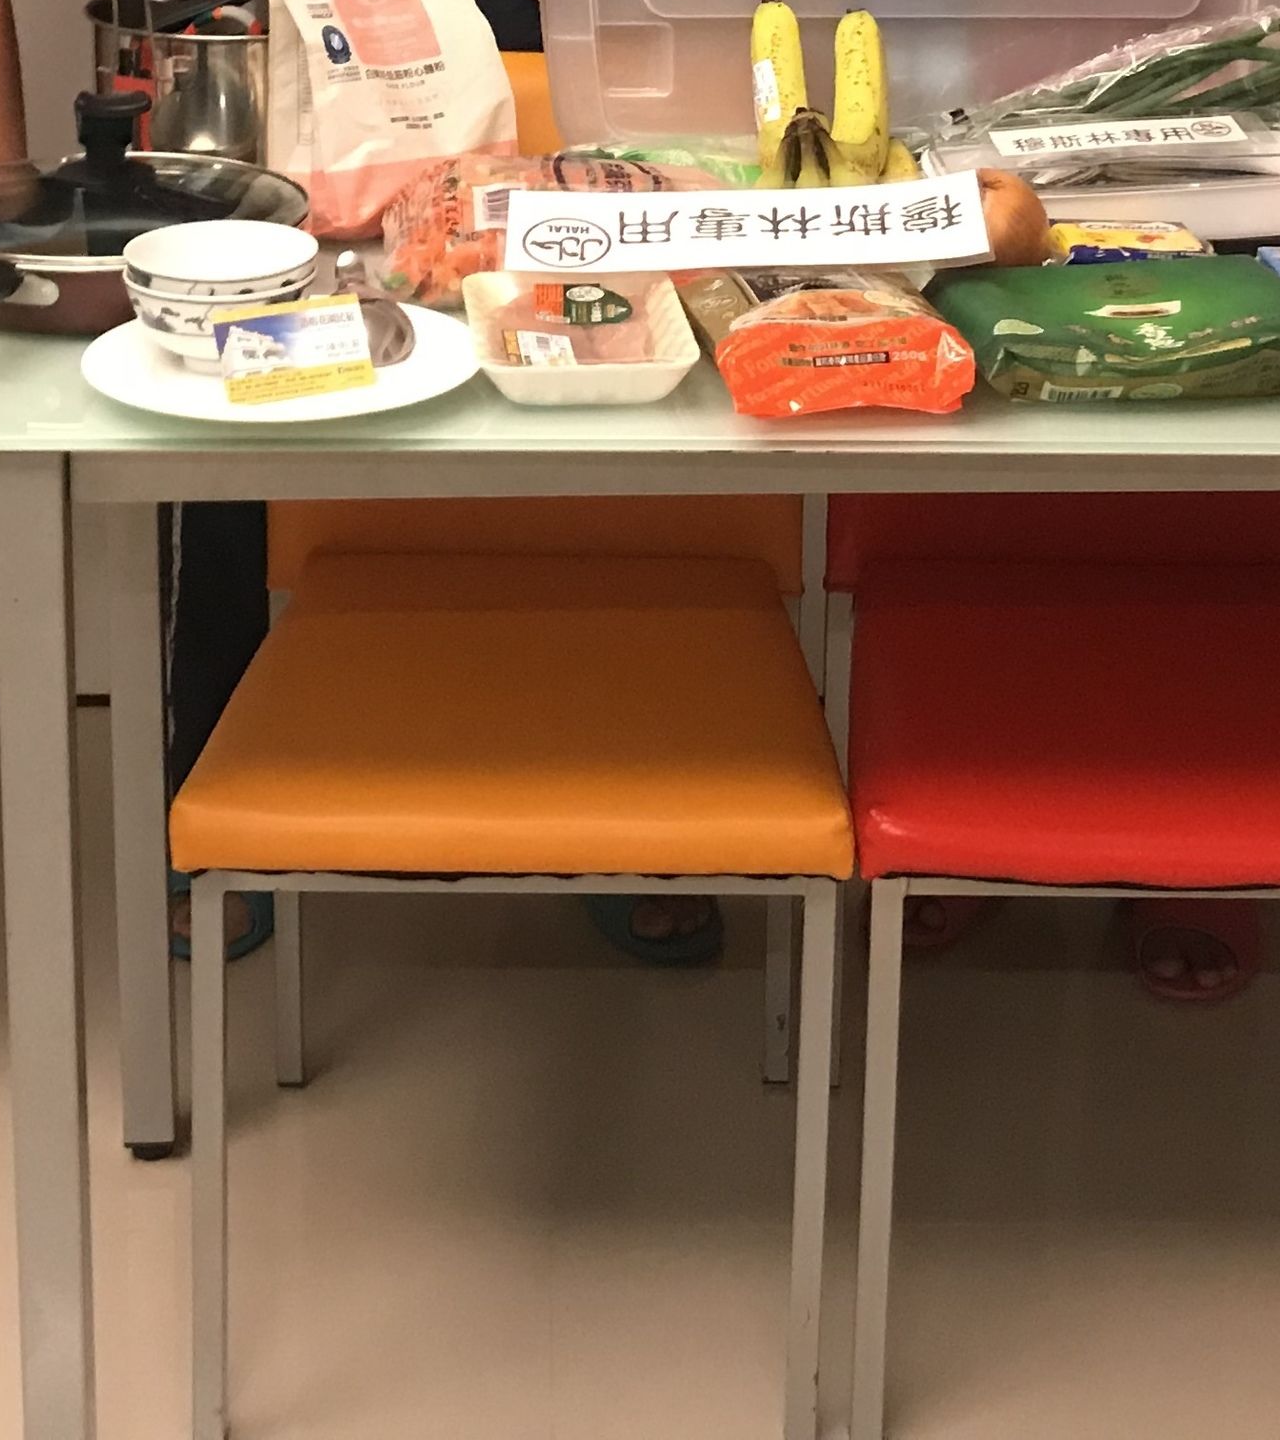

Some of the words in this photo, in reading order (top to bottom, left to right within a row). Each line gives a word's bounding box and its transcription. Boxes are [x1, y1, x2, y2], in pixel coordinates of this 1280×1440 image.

[1012, 126, 1195, 153] 穆斯林專用
[548, 224, 591, 234] HALAL
[618, 194, 964, 245] 穆斯林專用
